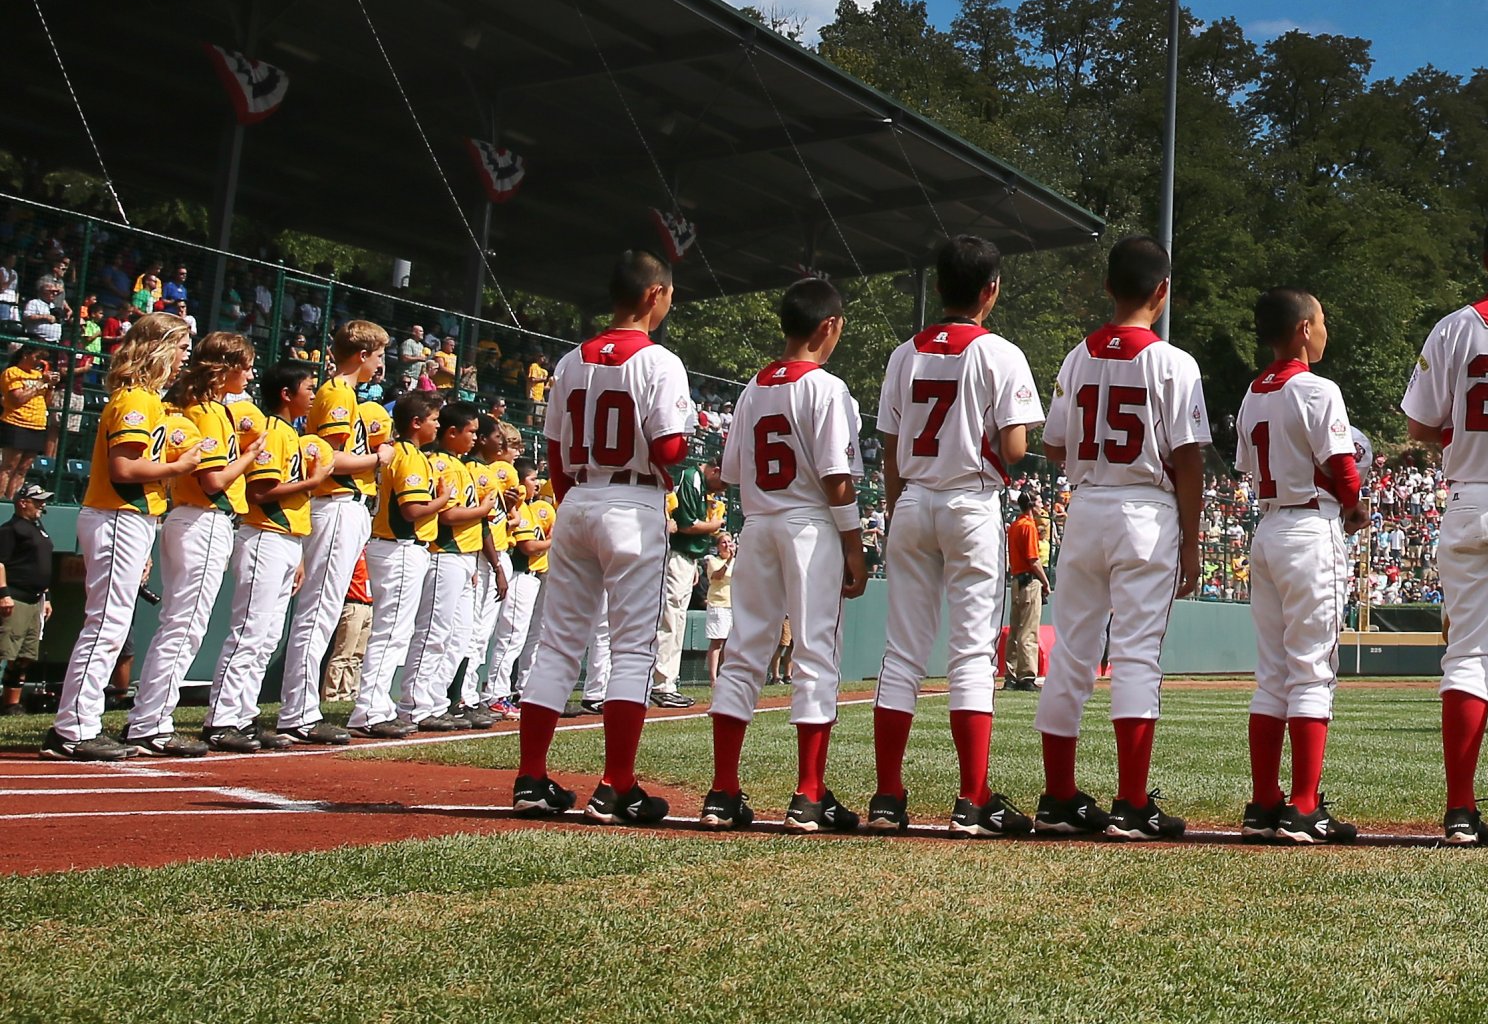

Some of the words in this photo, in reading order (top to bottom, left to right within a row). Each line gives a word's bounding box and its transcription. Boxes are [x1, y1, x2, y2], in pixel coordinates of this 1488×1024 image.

[567, 389, 635, 467] 10
[754, 414, 796, 491] 6
[912, 379, 958, 457] 7
[1077, 385, 1147, 464] 15
[1251, 421, 1277, 499] 1
